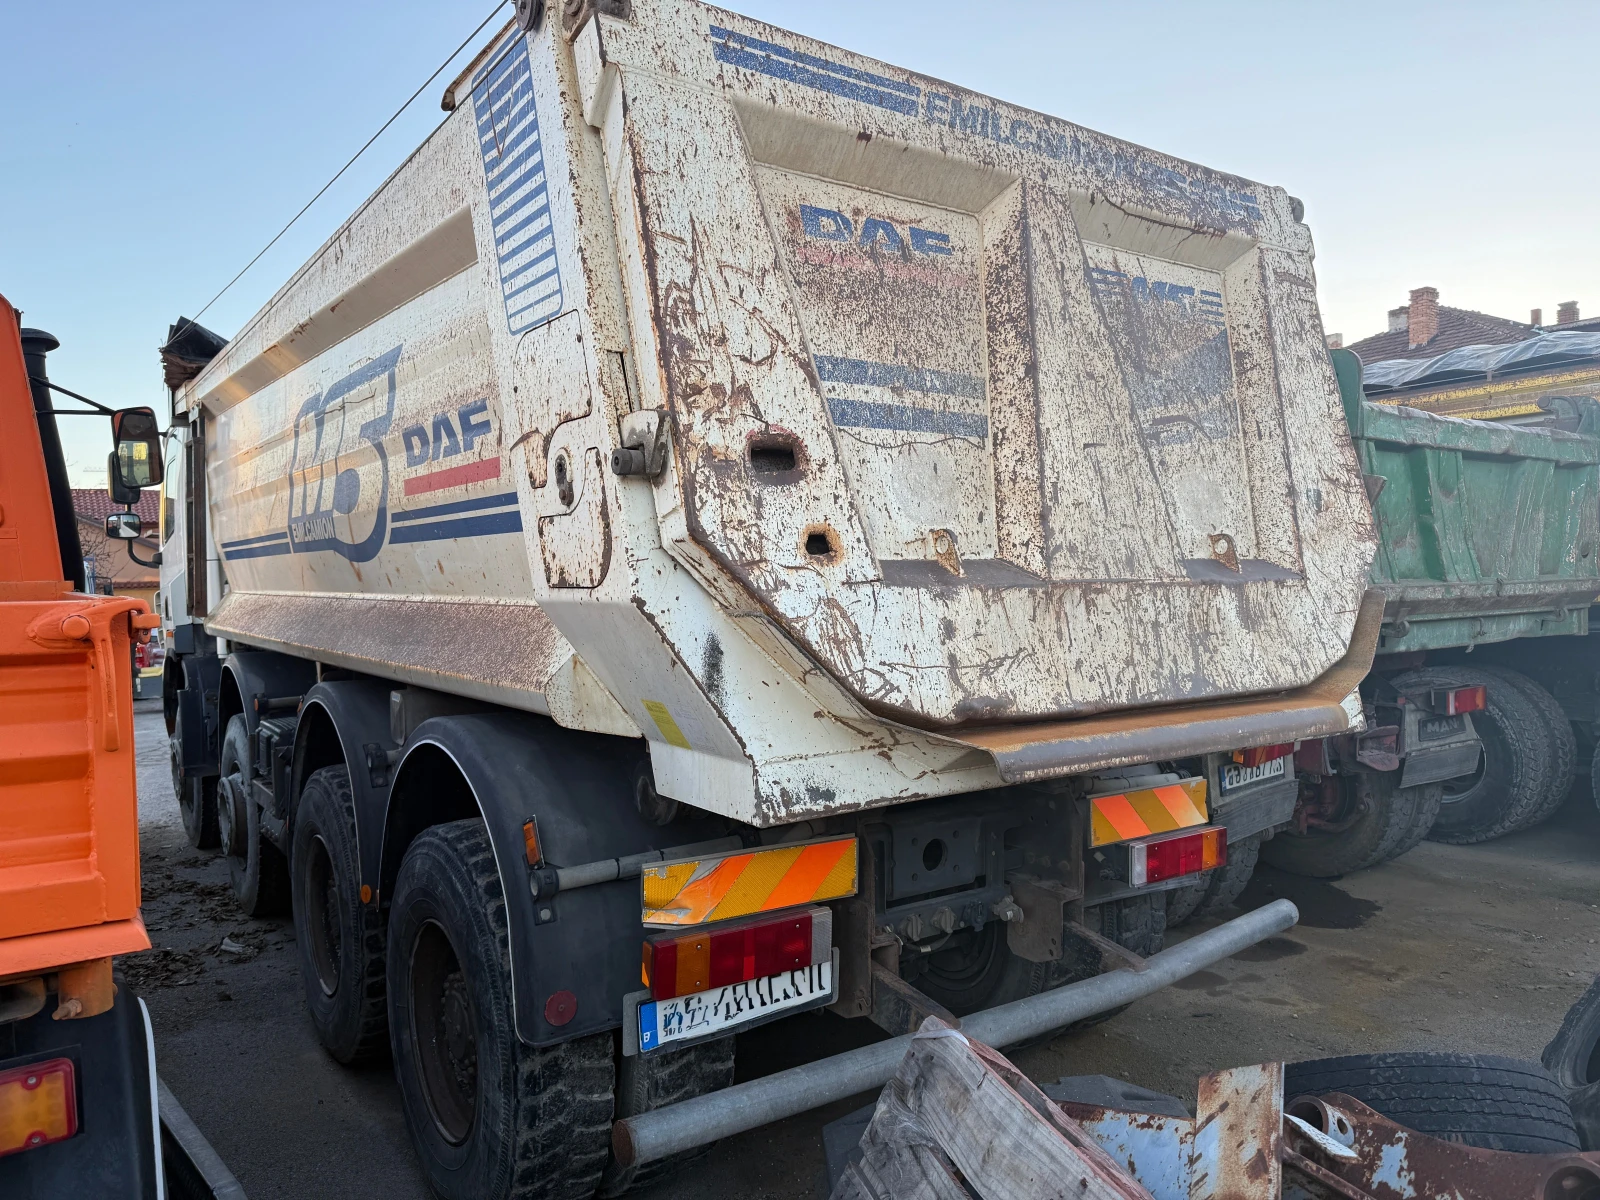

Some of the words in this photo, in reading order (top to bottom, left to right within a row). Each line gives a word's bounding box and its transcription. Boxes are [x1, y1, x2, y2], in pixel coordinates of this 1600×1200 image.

[800, 204, 953, 256] DAF
[403, 397, 492, 468] DAF
[1427, 717, 1460, 732] MAN
